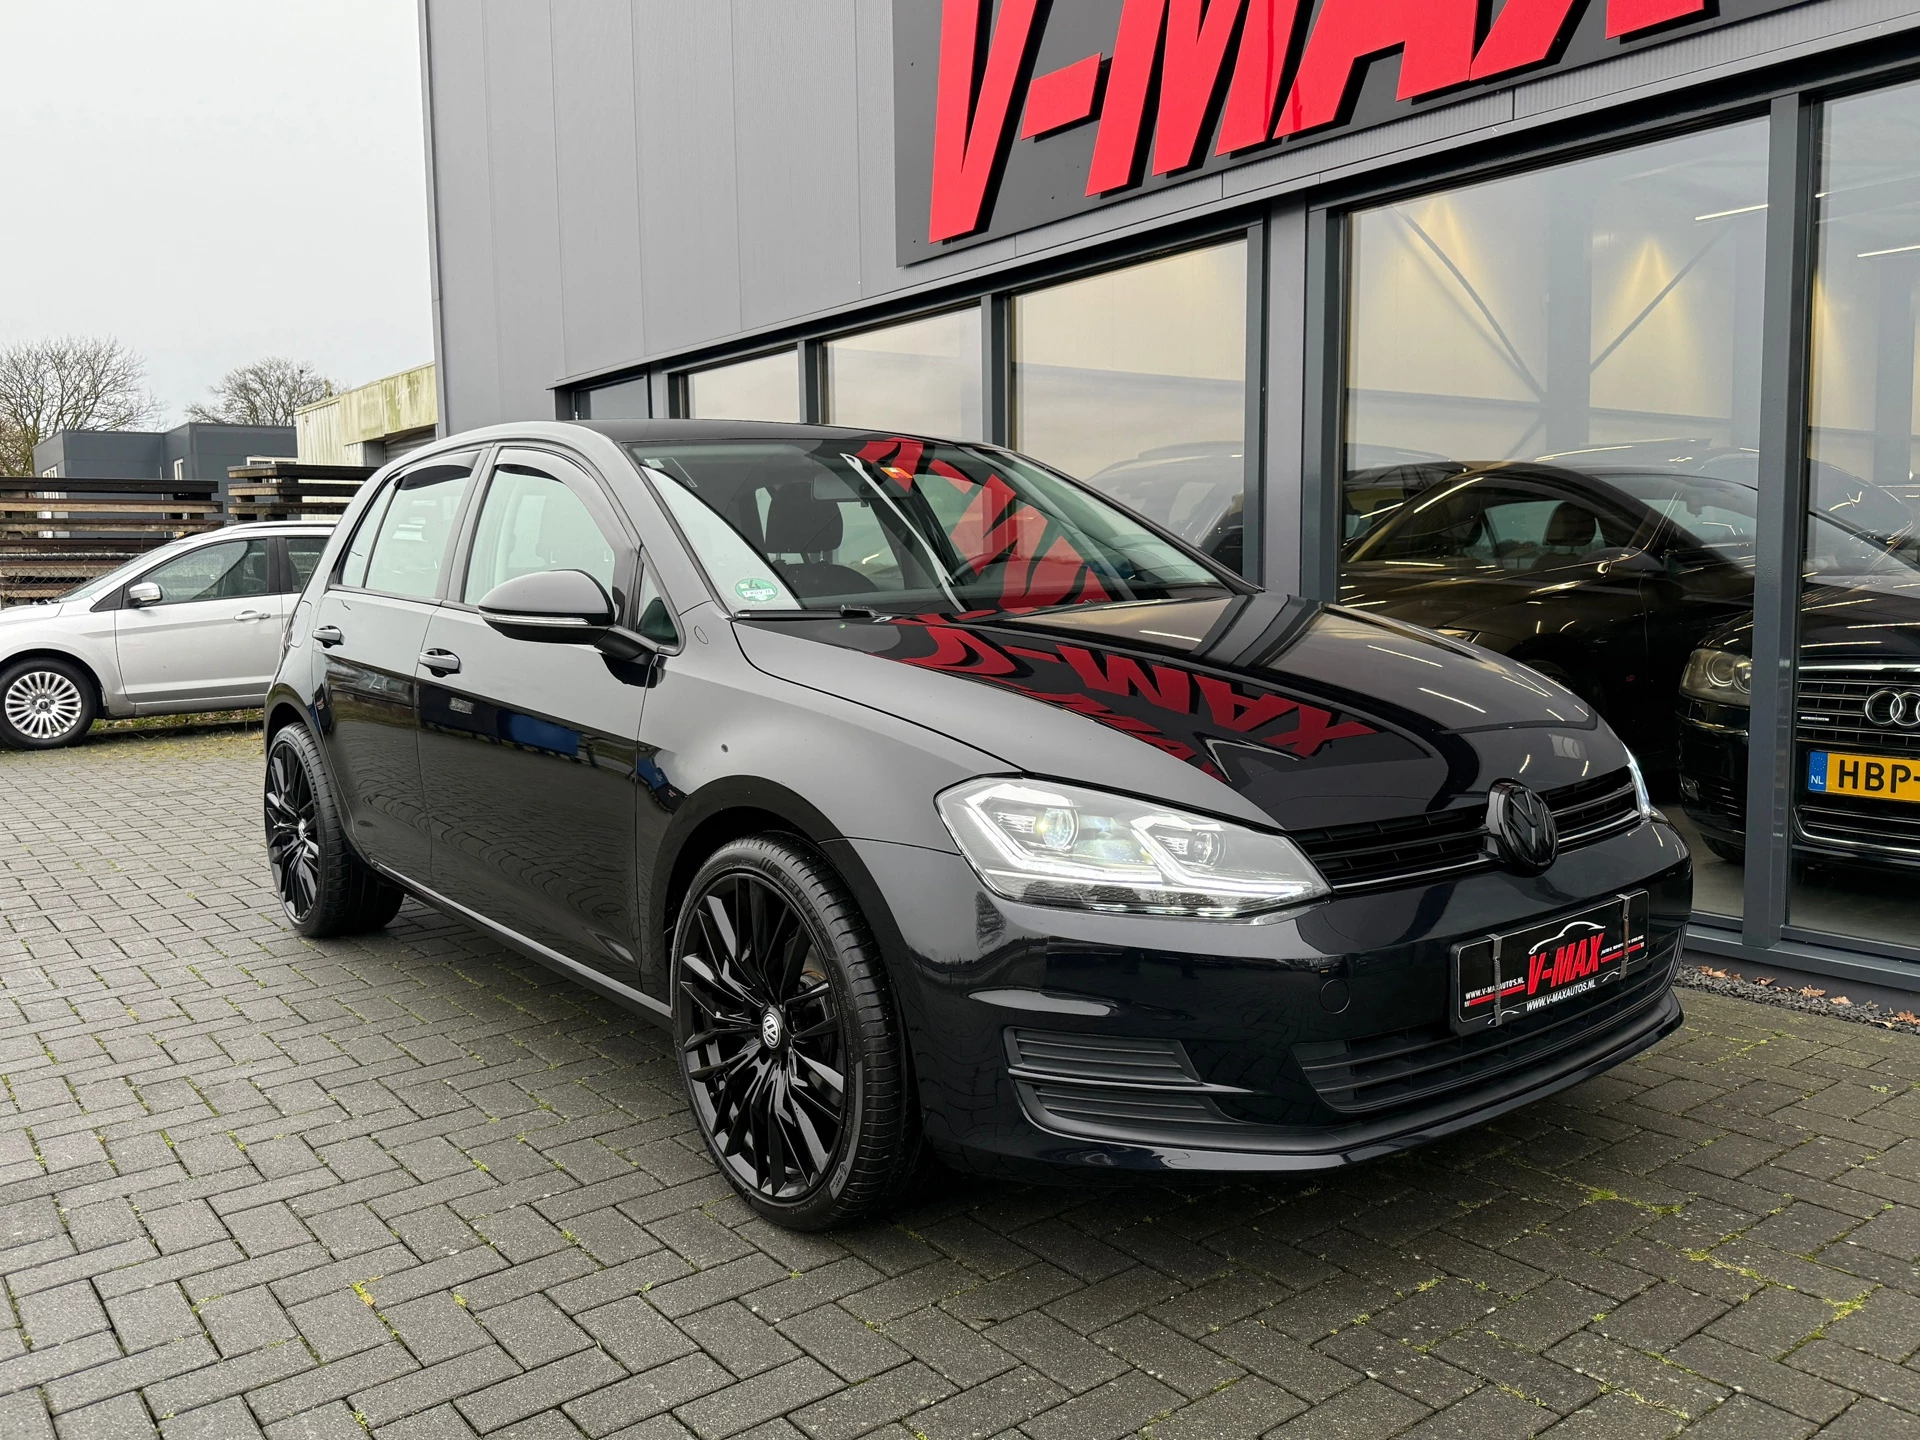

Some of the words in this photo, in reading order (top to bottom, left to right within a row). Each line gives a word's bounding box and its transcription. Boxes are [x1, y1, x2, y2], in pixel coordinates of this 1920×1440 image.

[929, 0, 1703, 243] V-M
[1810, 774, 1824, 785] NL
[1527, 932, 1604, 996] V-MAX
[1526, 979, 1596, 1012] WWW.V-MAXAUTOS.NL
